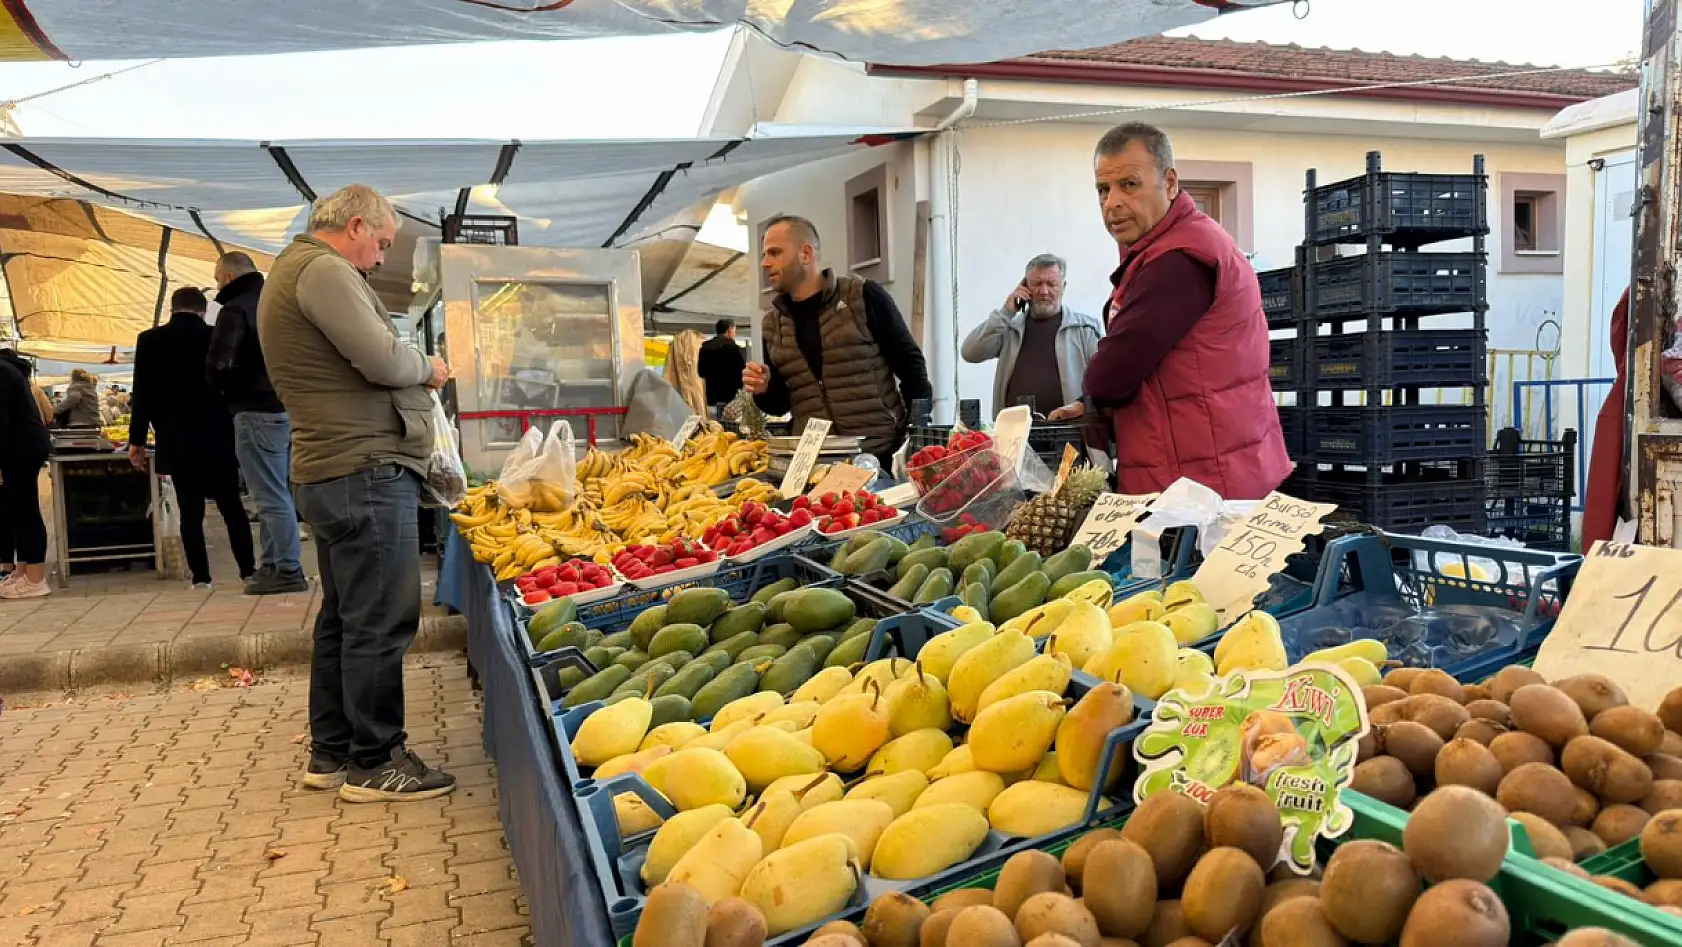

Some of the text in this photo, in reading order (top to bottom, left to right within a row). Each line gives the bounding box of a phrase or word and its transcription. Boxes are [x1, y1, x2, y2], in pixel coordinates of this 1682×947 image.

[1264, 495, 1317, 518] Bursa
[1187, 704, 1225, 720] SUPER
[1182, 721, 1208, 737] LUX
[1276, 771, 1326, 793] fresh
[1276, 793, 1324, 812] fruit
